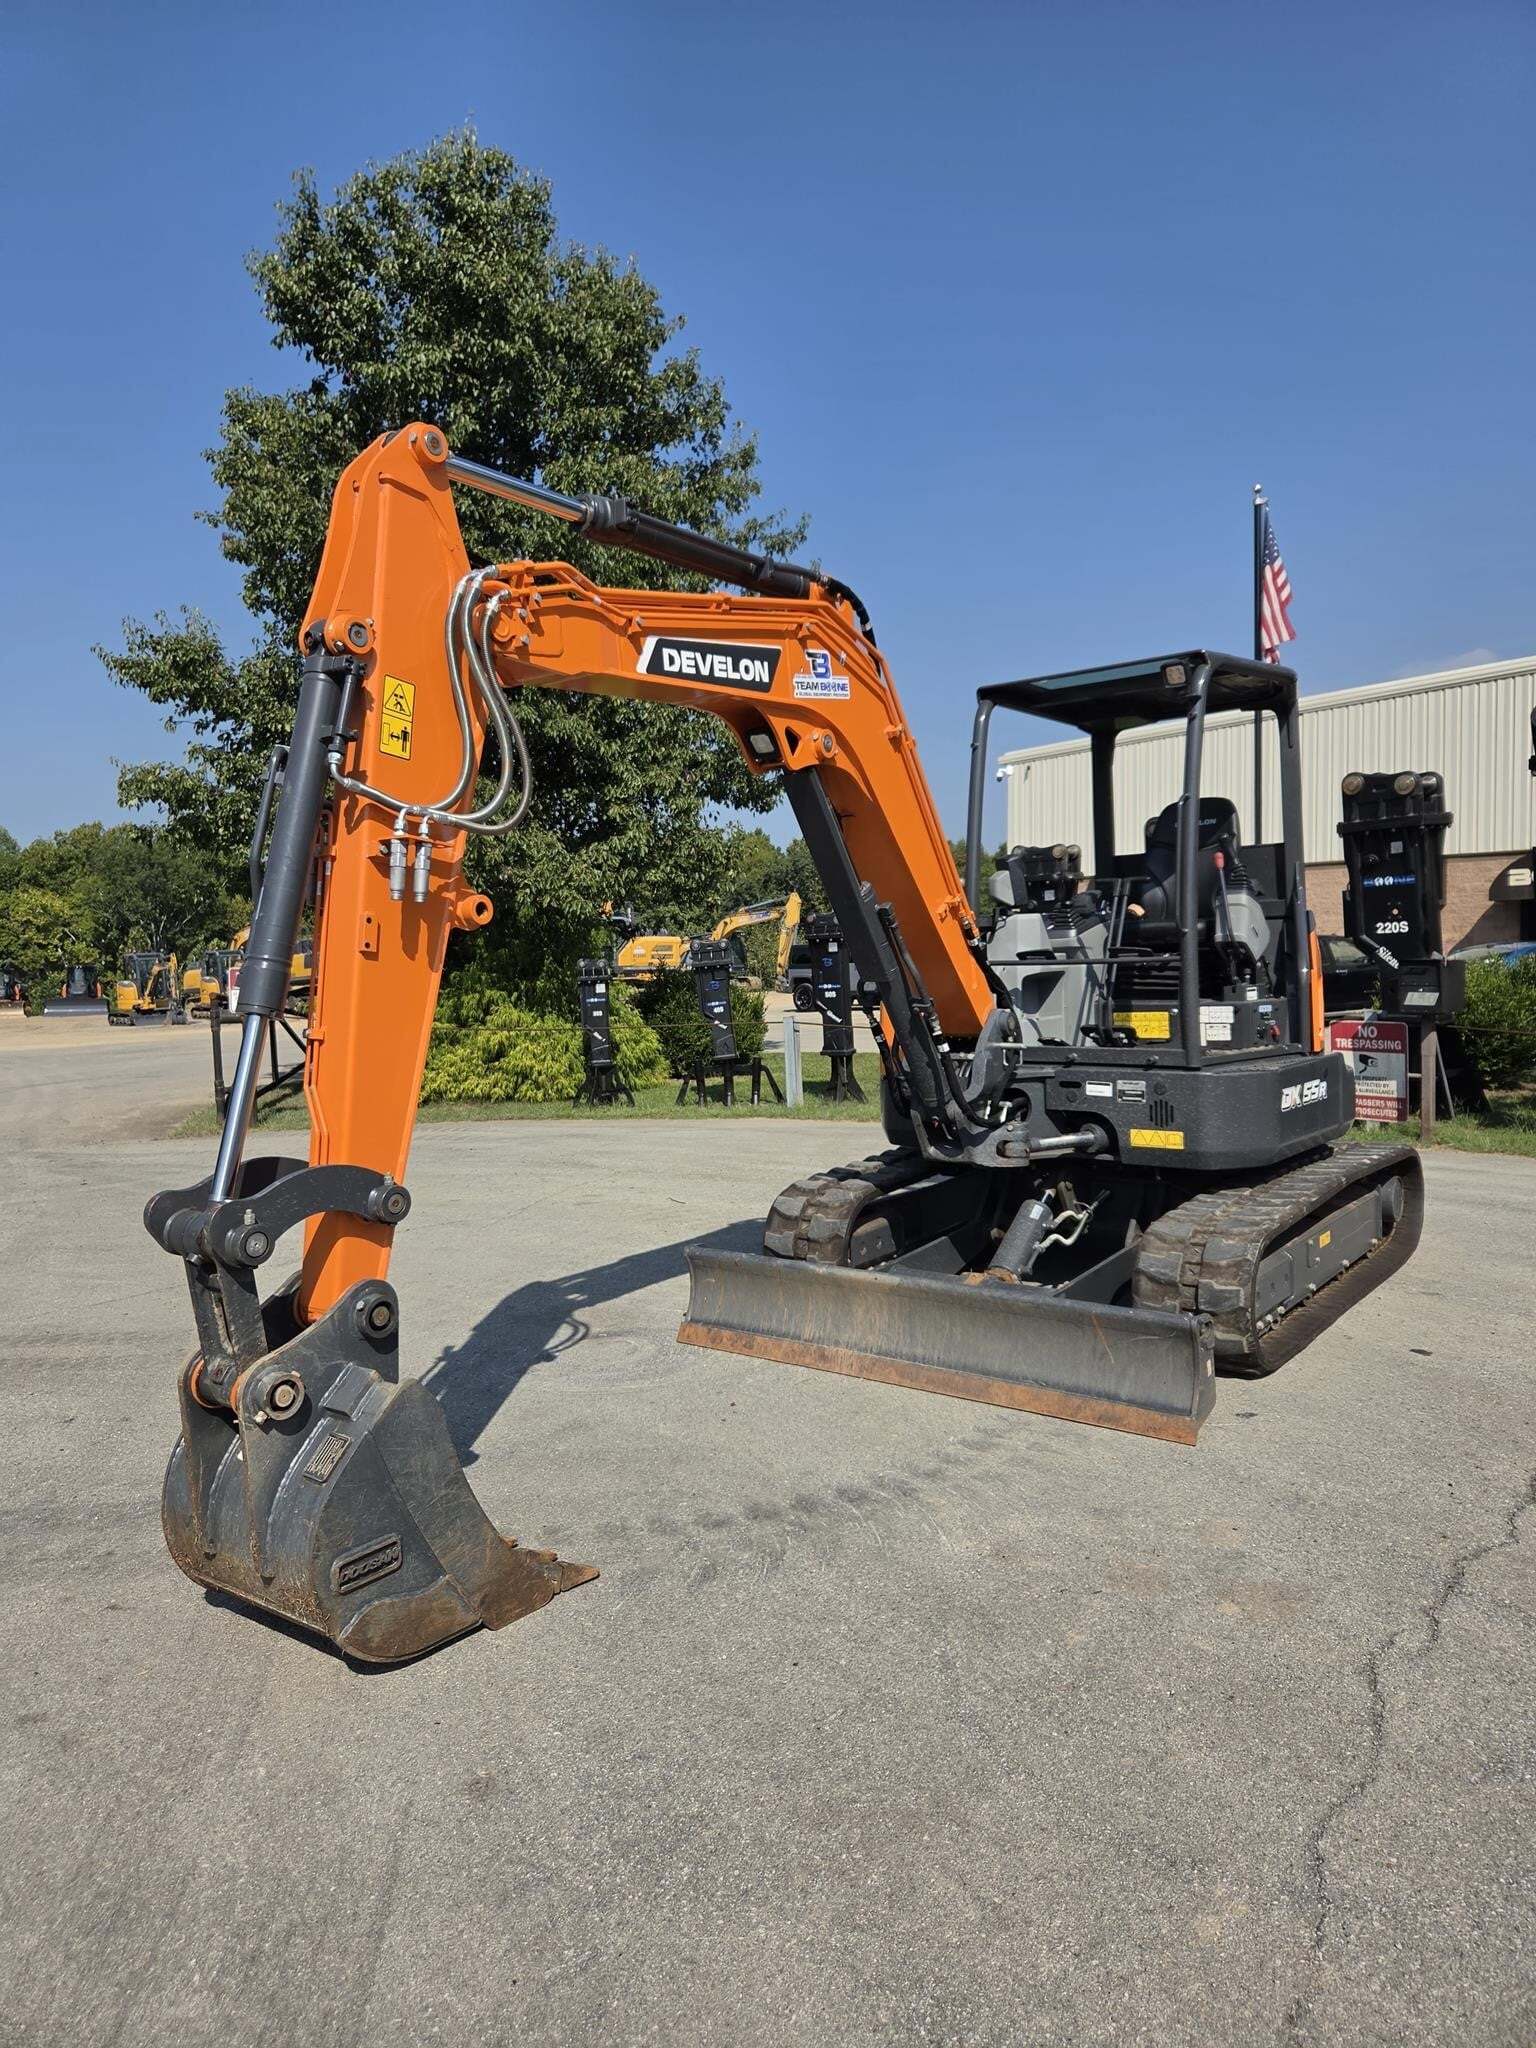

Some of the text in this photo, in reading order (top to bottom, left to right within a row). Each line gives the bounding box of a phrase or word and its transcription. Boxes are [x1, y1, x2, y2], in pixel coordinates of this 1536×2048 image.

[662, 647, 769, 683] DEVELON
[795, 681, 819, 691] TEAM
[1376, 921, 1409, 934] 220S
[1358, 1026, 1378, 1038] NO
[1335, 1038, 1402, 1049] TRESPASSING
[1386, 1101, 1402, 1109] WILL
